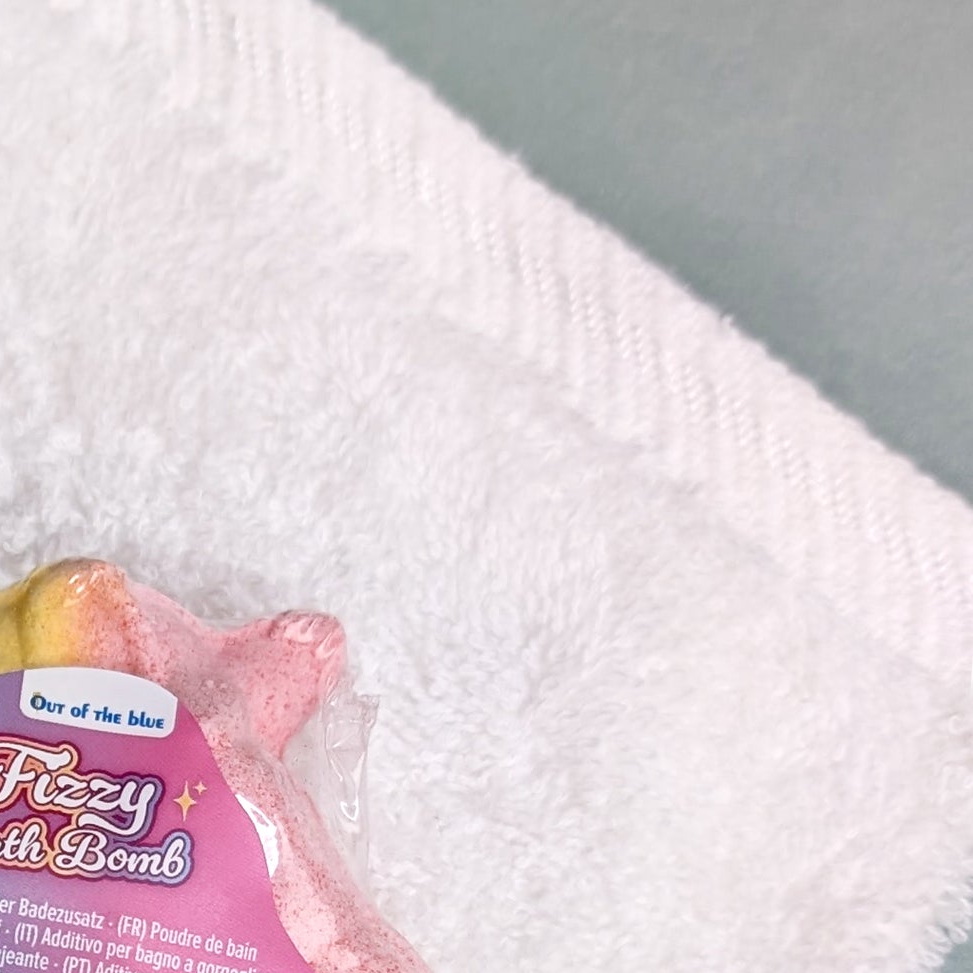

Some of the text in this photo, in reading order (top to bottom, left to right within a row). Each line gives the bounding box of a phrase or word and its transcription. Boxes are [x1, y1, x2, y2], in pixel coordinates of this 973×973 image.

[54, 830, 185, 878] Bomb
[15, 923, 38, 946] (IT)
[42, 927, 102, 953] Additivo
[107, 941, 131, 958] per
[135, 946, 180, 971] bagno
[184, 957, 192, 971] a
[19, 898, 105, 929] Badezusatz
[118, 915, 146, 940] (FR)
[151, 922, 201, 948] Poudre
[205, 935, 222, 954] de
[226, 942, 258, 961] bain
